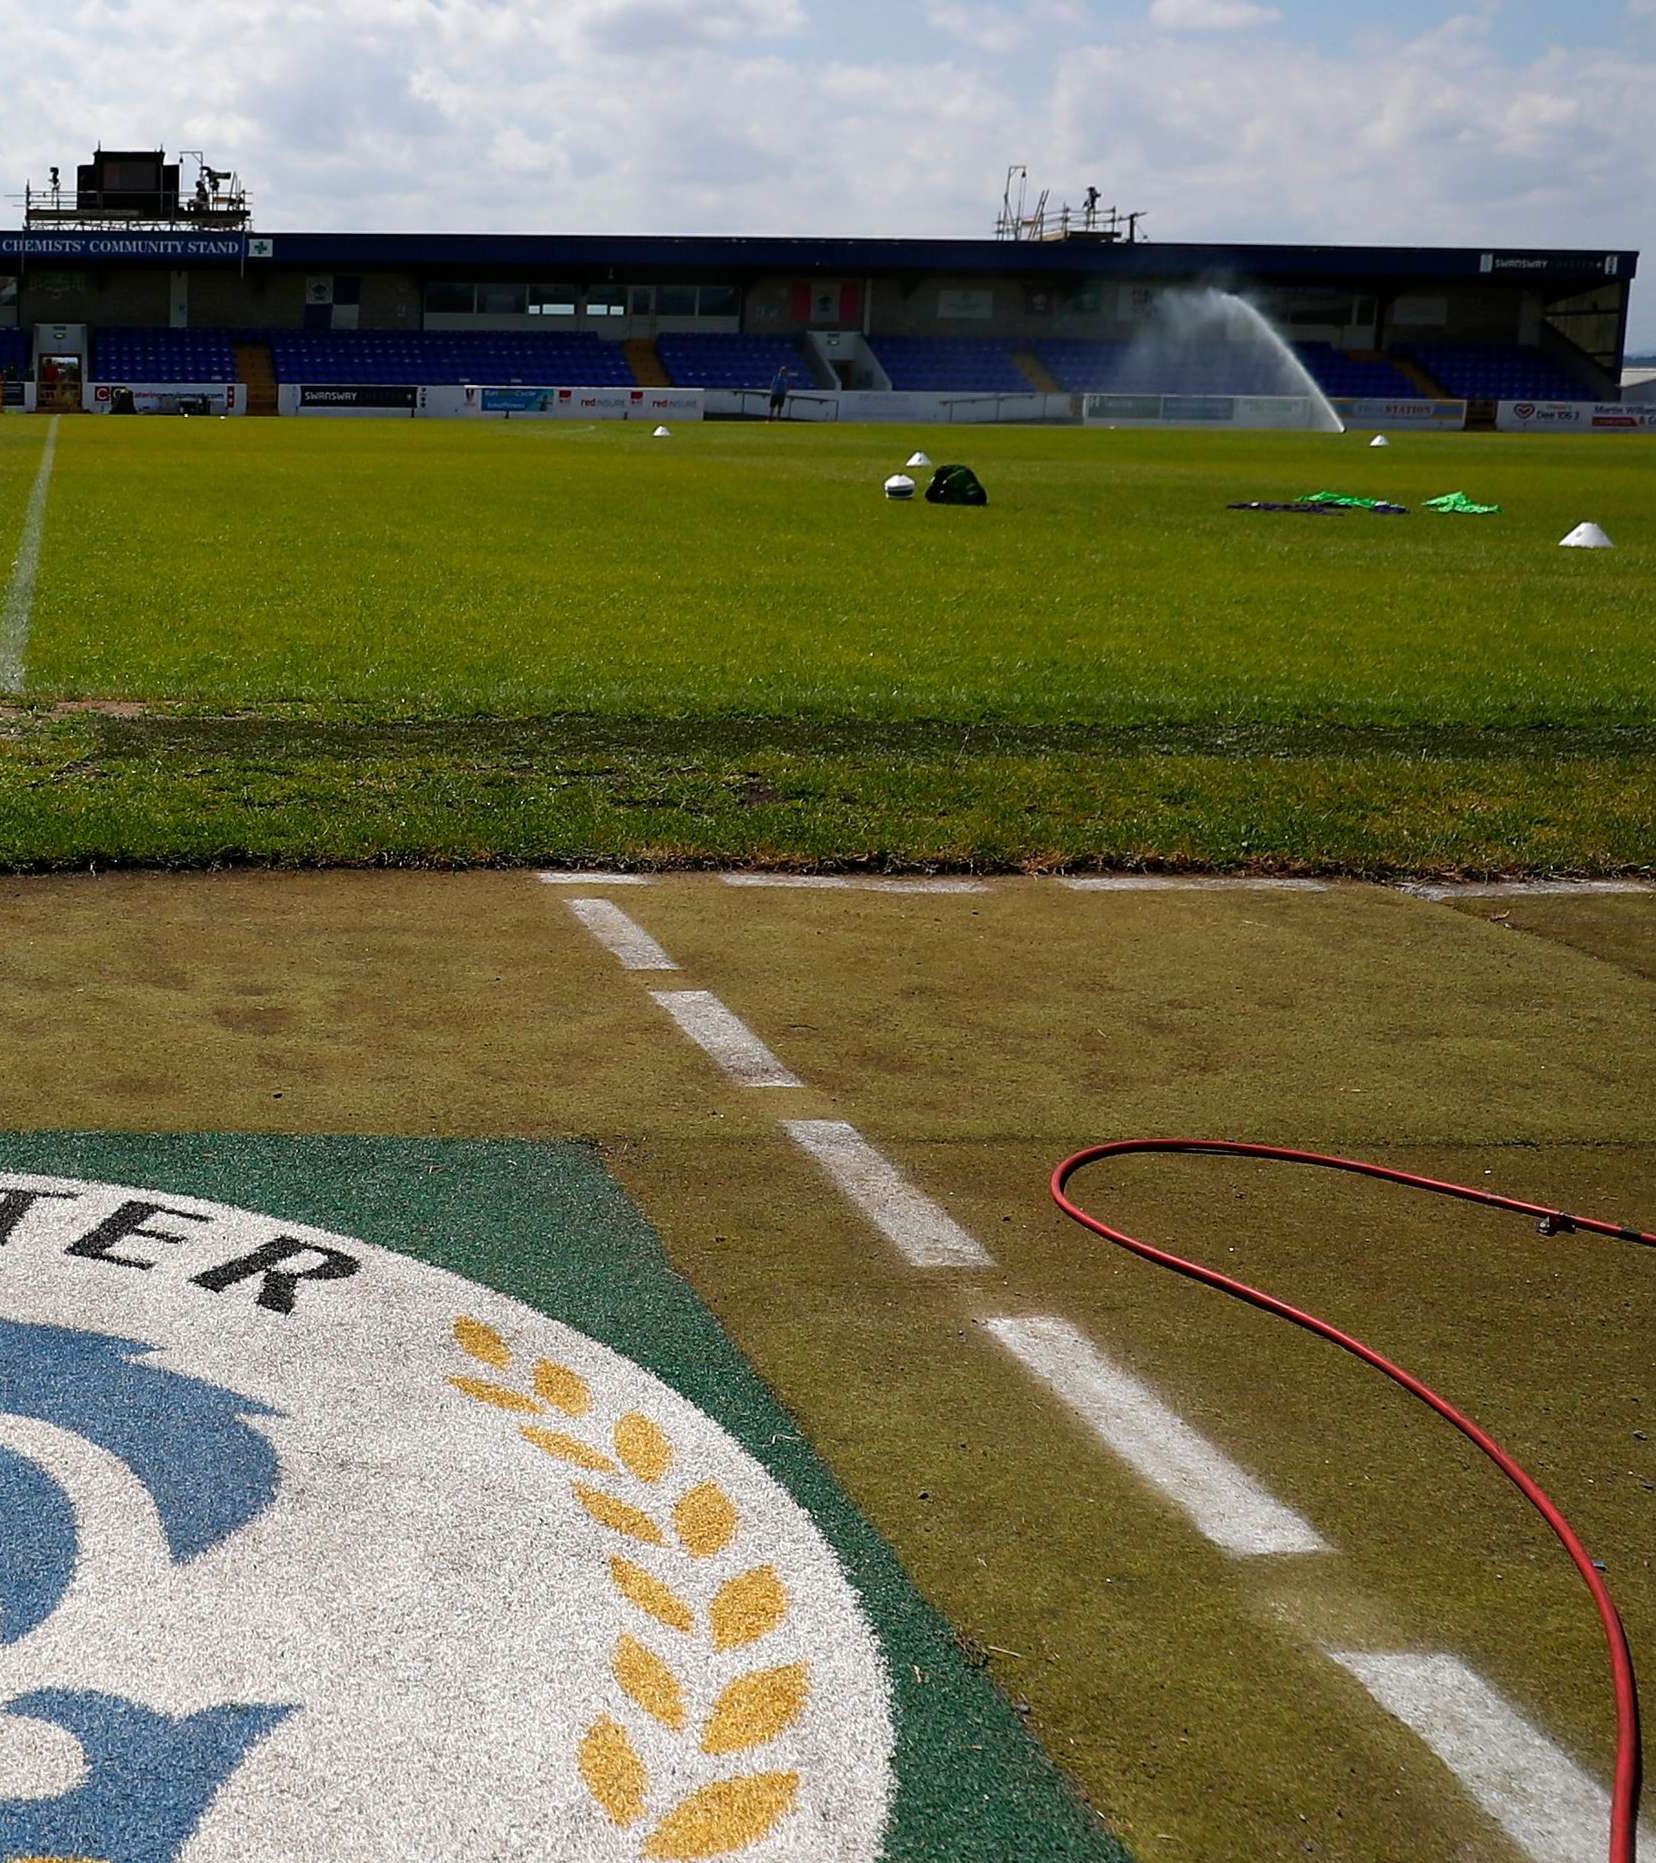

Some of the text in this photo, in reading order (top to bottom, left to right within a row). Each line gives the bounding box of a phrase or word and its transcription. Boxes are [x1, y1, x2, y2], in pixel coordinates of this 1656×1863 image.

[89, 240, 184, 254] COMMUNITY
[187, 242, 239, 255] STAND
[1494, 258, 1549, 270] SWANSWAY
[304, 391, 358, 401] SWANSWAY
